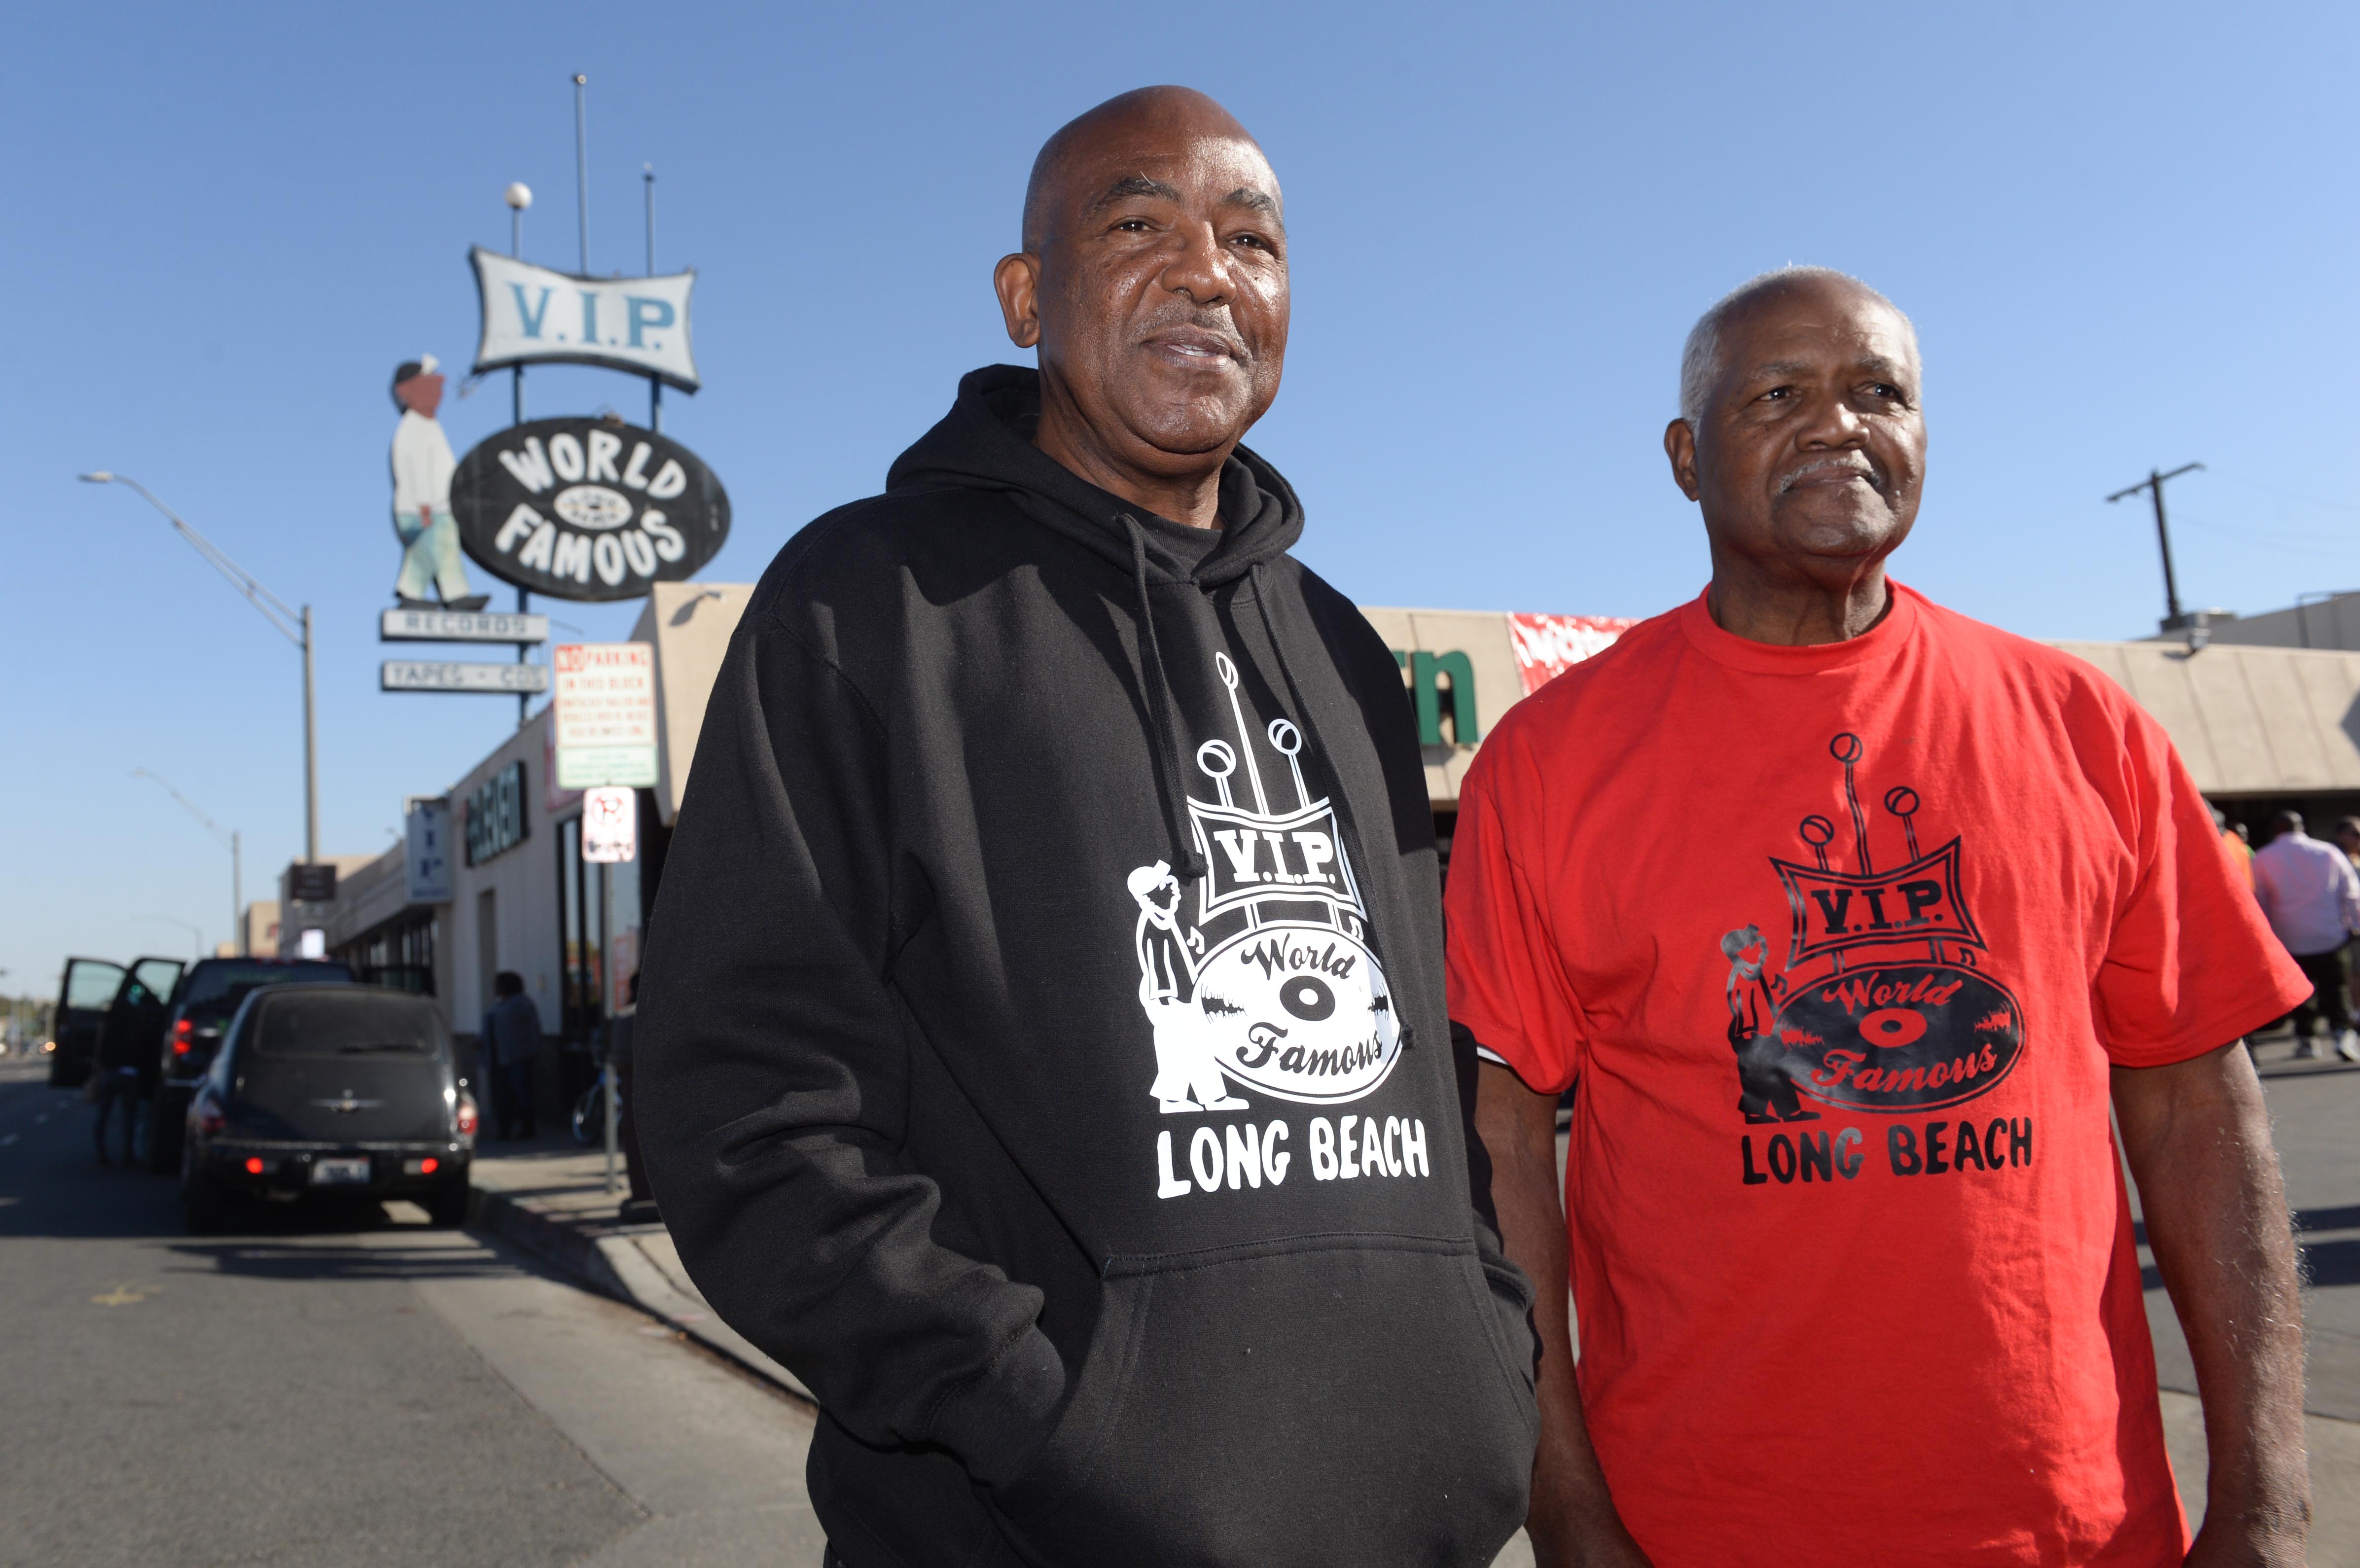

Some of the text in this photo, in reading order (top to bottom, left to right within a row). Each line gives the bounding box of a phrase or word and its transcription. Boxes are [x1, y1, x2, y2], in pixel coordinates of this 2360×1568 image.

[508, 282, 676, 350] V.I.P.
[498, 429, 687, 499] WORLD
[494, 503, 687, 586] FAMOUS
[405, 612, 527, 633] RECORDS
[393, 664, 464, 685] TAPES
[558, 649, 647, 669] NO PARKING
[1392, 650, 1478, 744] n
[1214, 829, 1336, 883] V.I.P.
[1811, 880, 1943, 934] V.I.P.
[1241, 933, 1356, 980] World
[1823, 973, 1963, 1014] World
[1236, 1022, 1382, 1076] Famous
[1811, 1044, 1997, 1093] Famous
[1157, 1115, 1430, 1199] LONG BEACH
[1742, 1117, 2033, 1185] LONG BEACH
